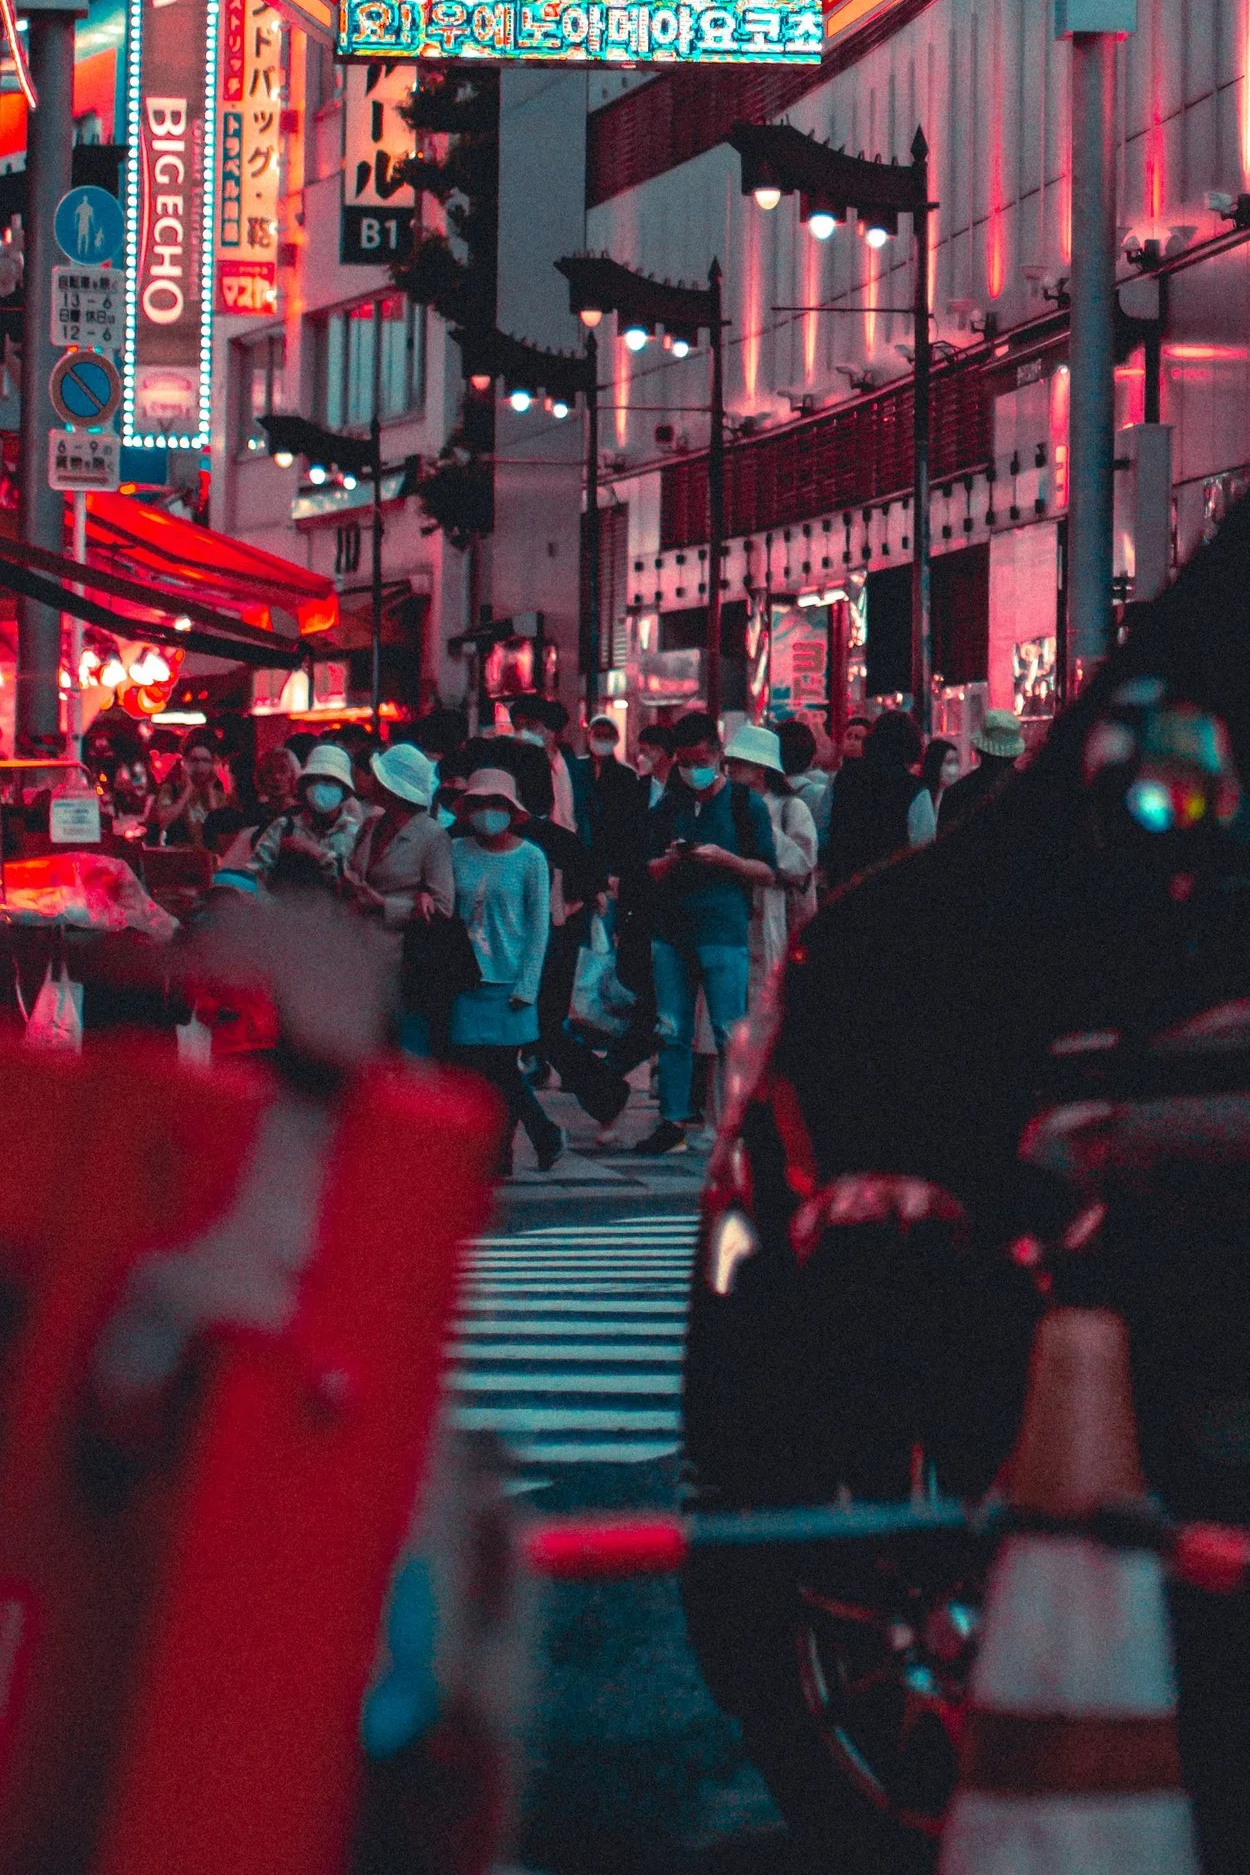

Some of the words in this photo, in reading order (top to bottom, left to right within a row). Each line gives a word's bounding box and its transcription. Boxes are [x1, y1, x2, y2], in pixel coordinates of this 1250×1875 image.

[144, 97, 188, 185] BIG
[141, 195, 185, 325] ECHO
[360, 218, 397, 250] B1
